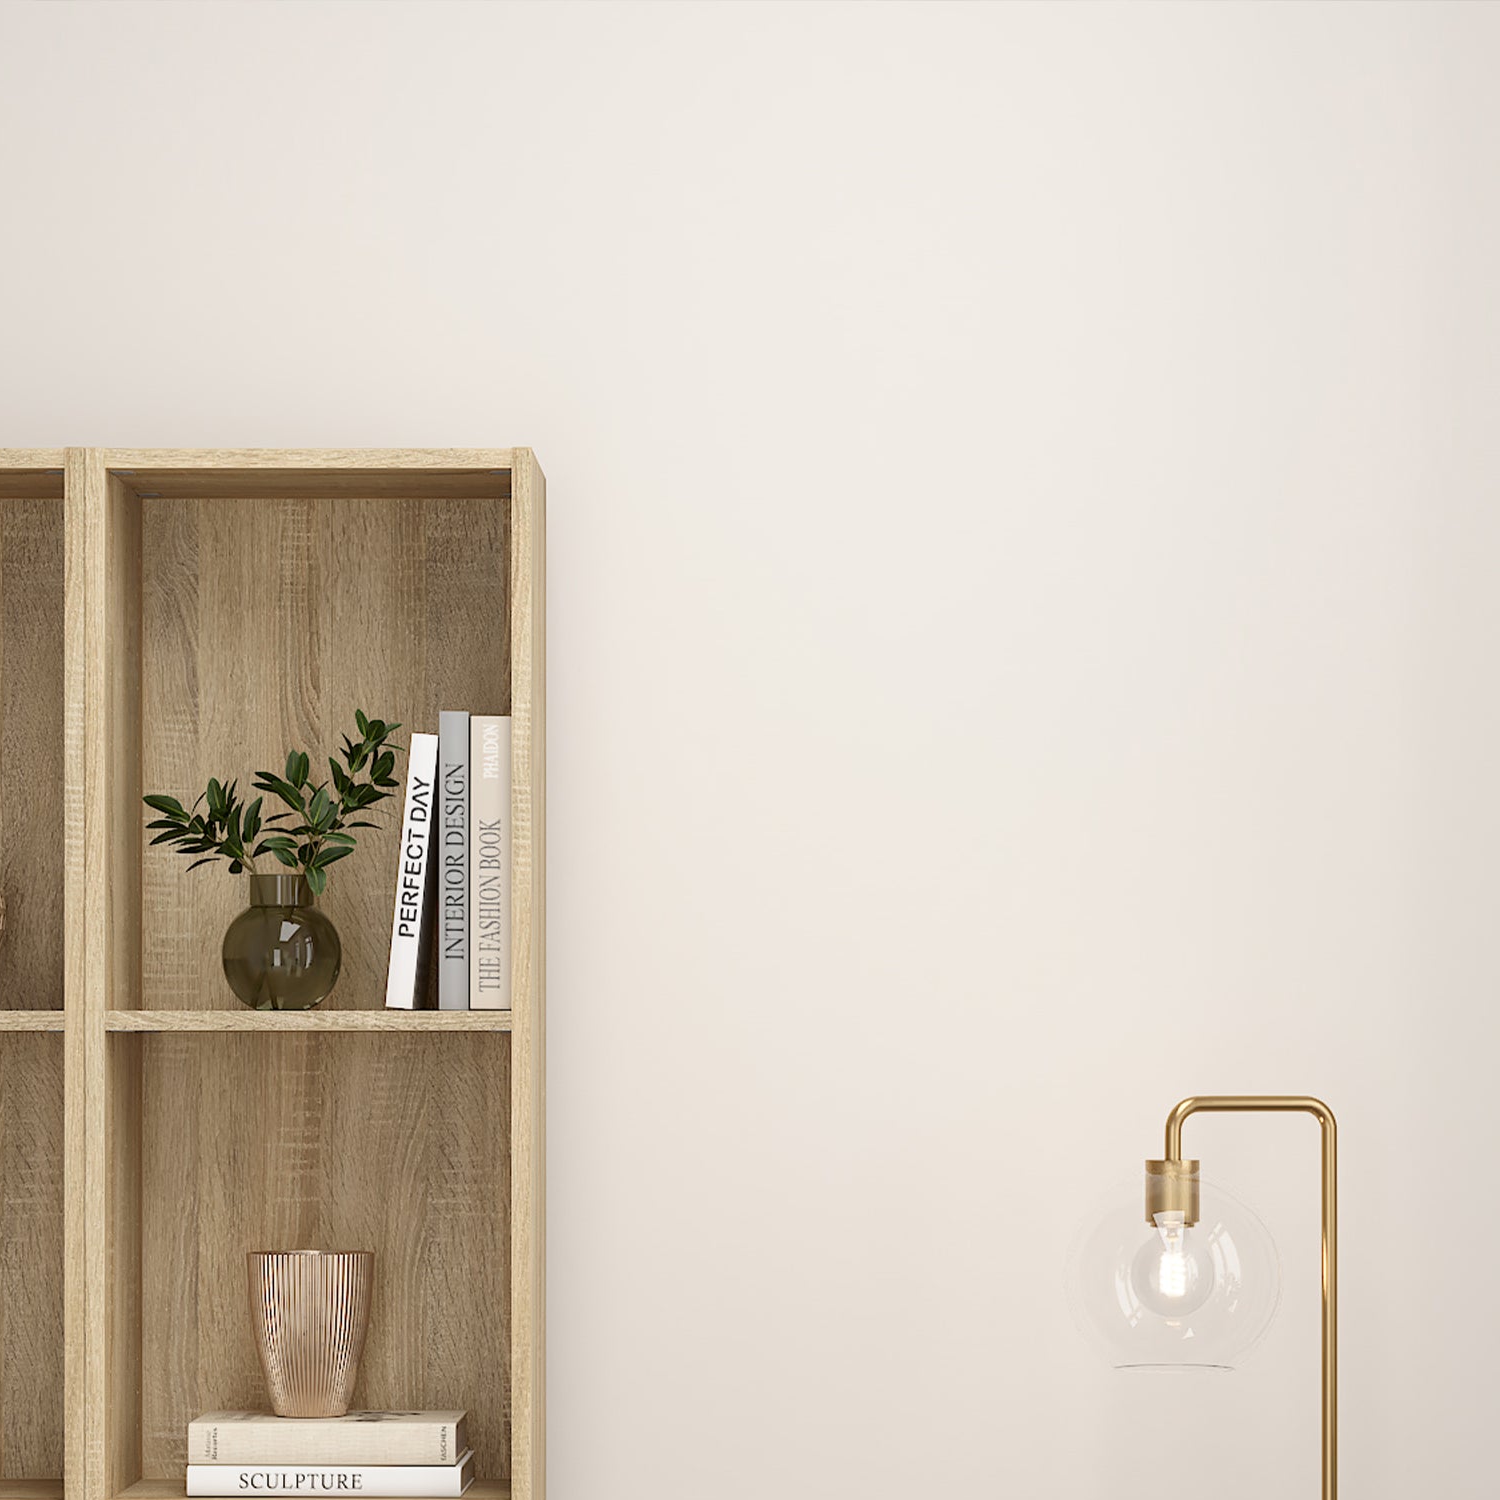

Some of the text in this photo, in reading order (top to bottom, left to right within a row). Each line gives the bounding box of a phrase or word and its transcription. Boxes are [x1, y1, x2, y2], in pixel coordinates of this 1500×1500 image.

[482, 723, 500, 780] PHAIDON
[398, 776, 431, 939] PERFECT DAY
[444, 762, 466, 962] INTERIOR DESIGN
[478, 818, 502, 993] THE FASHION BOOK
[238, 1471, 364, 1491] SCULPTURE
